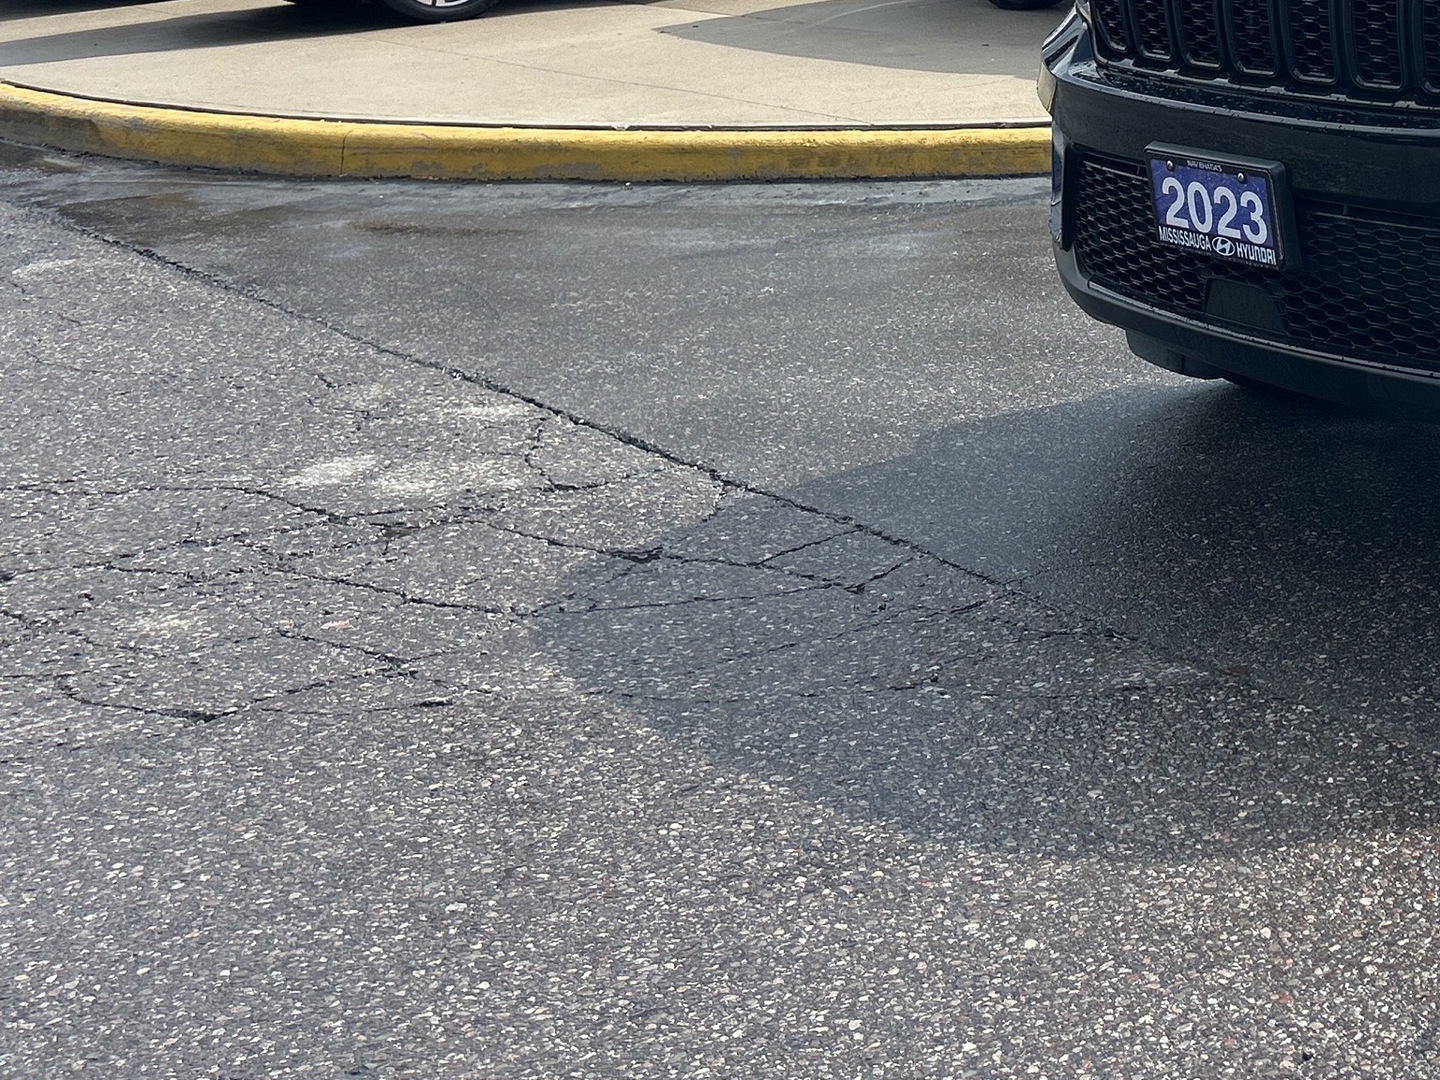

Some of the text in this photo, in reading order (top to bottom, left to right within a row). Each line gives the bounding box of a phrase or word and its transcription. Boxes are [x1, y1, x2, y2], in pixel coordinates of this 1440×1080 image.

[1162, 177, 1268, 245] 2023
[1158, 225, 1213, 252] MISSISSAUGA
[1236, 241, 1277, 266] HYUNDAI
